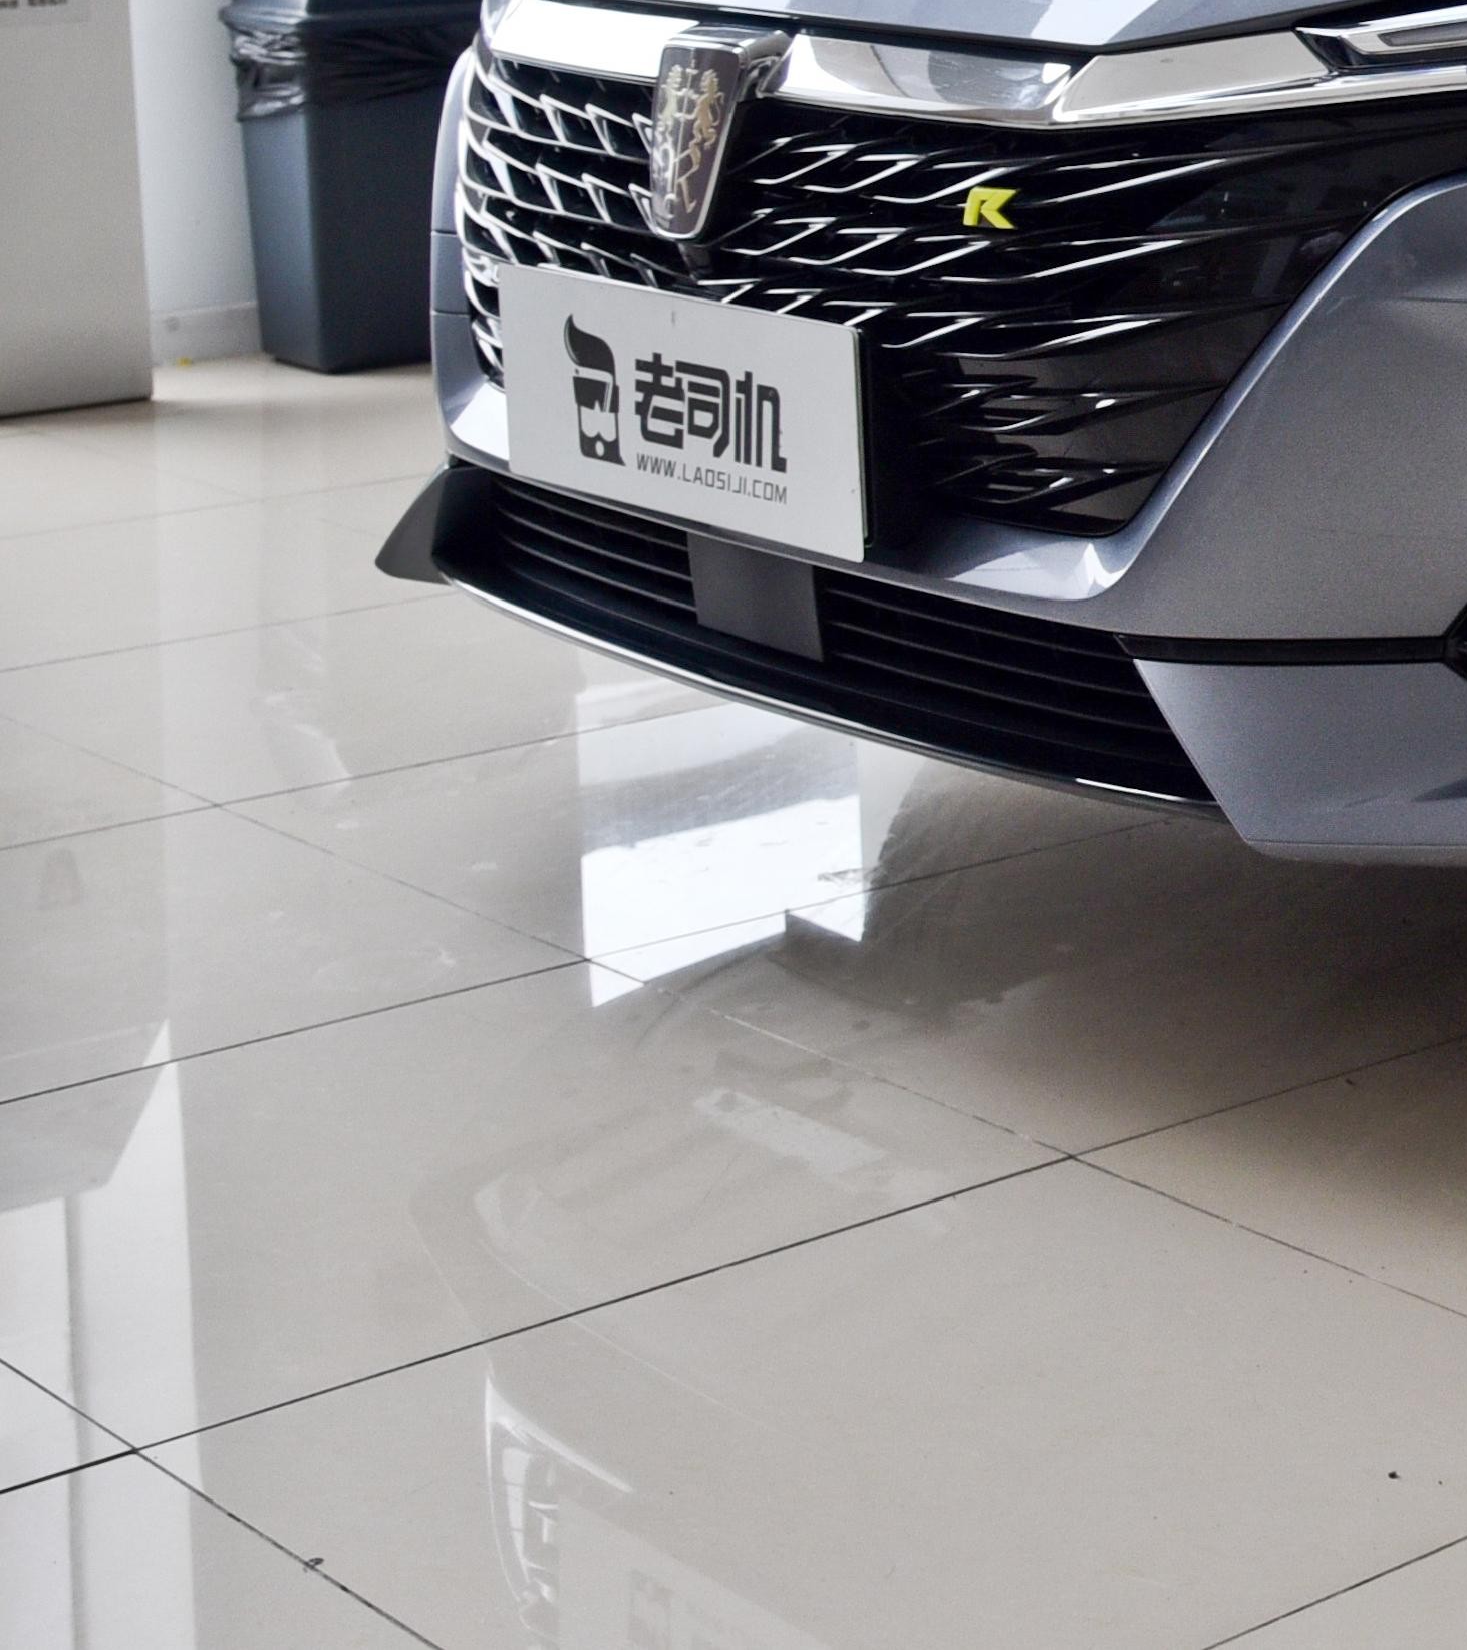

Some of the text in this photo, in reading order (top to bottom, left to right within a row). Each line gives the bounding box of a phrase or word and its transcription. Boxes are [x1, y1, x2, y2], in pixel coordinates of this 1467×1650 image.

[634, 352, 788, 474] 老司机
[635, 452, 788, 505] WWW.LAOSIJI.COM
